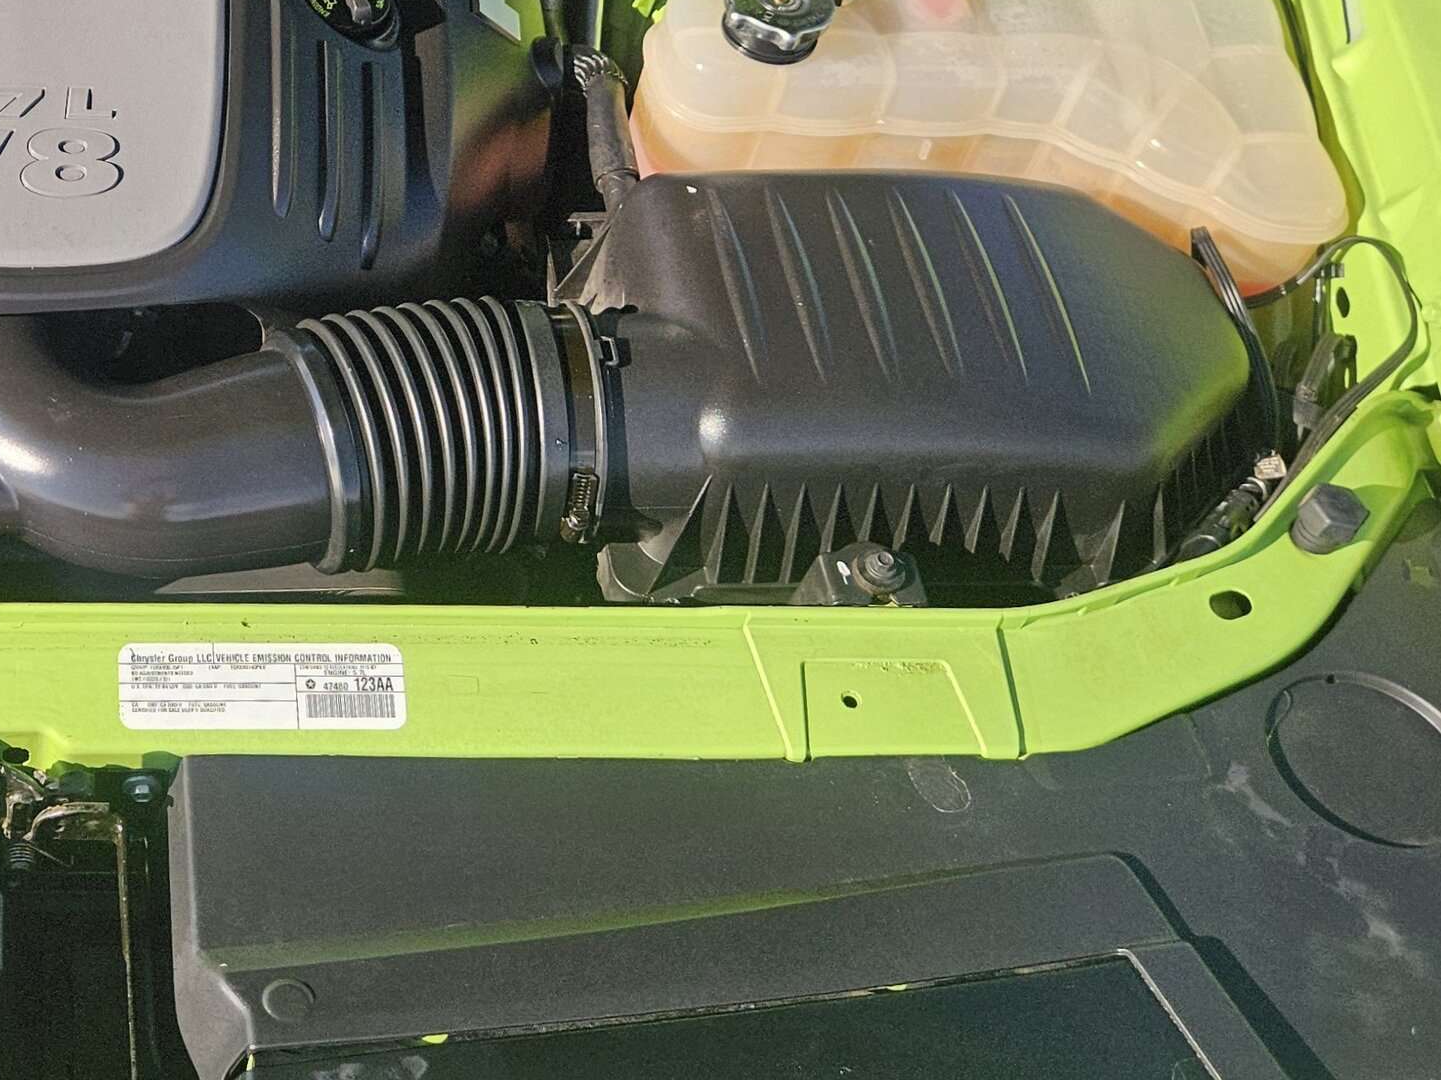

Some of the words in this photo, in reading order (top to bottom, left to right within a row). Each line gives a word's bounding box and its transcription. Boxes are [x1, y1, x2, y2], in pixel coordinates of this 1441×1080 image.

[131, 653, 165, 664] Chrysler
[168, 653, 194, 664] Group
[196, 653, 212, 662] LLC
[216, 653, 249, 662] VEHICLE
[252, 653, 292, 662] EMISSION
[295, 653, 332, 662] CONTROL
[334, 653, 392, 662] INFORMATION
[355, 677, 393, 691] 123AA
